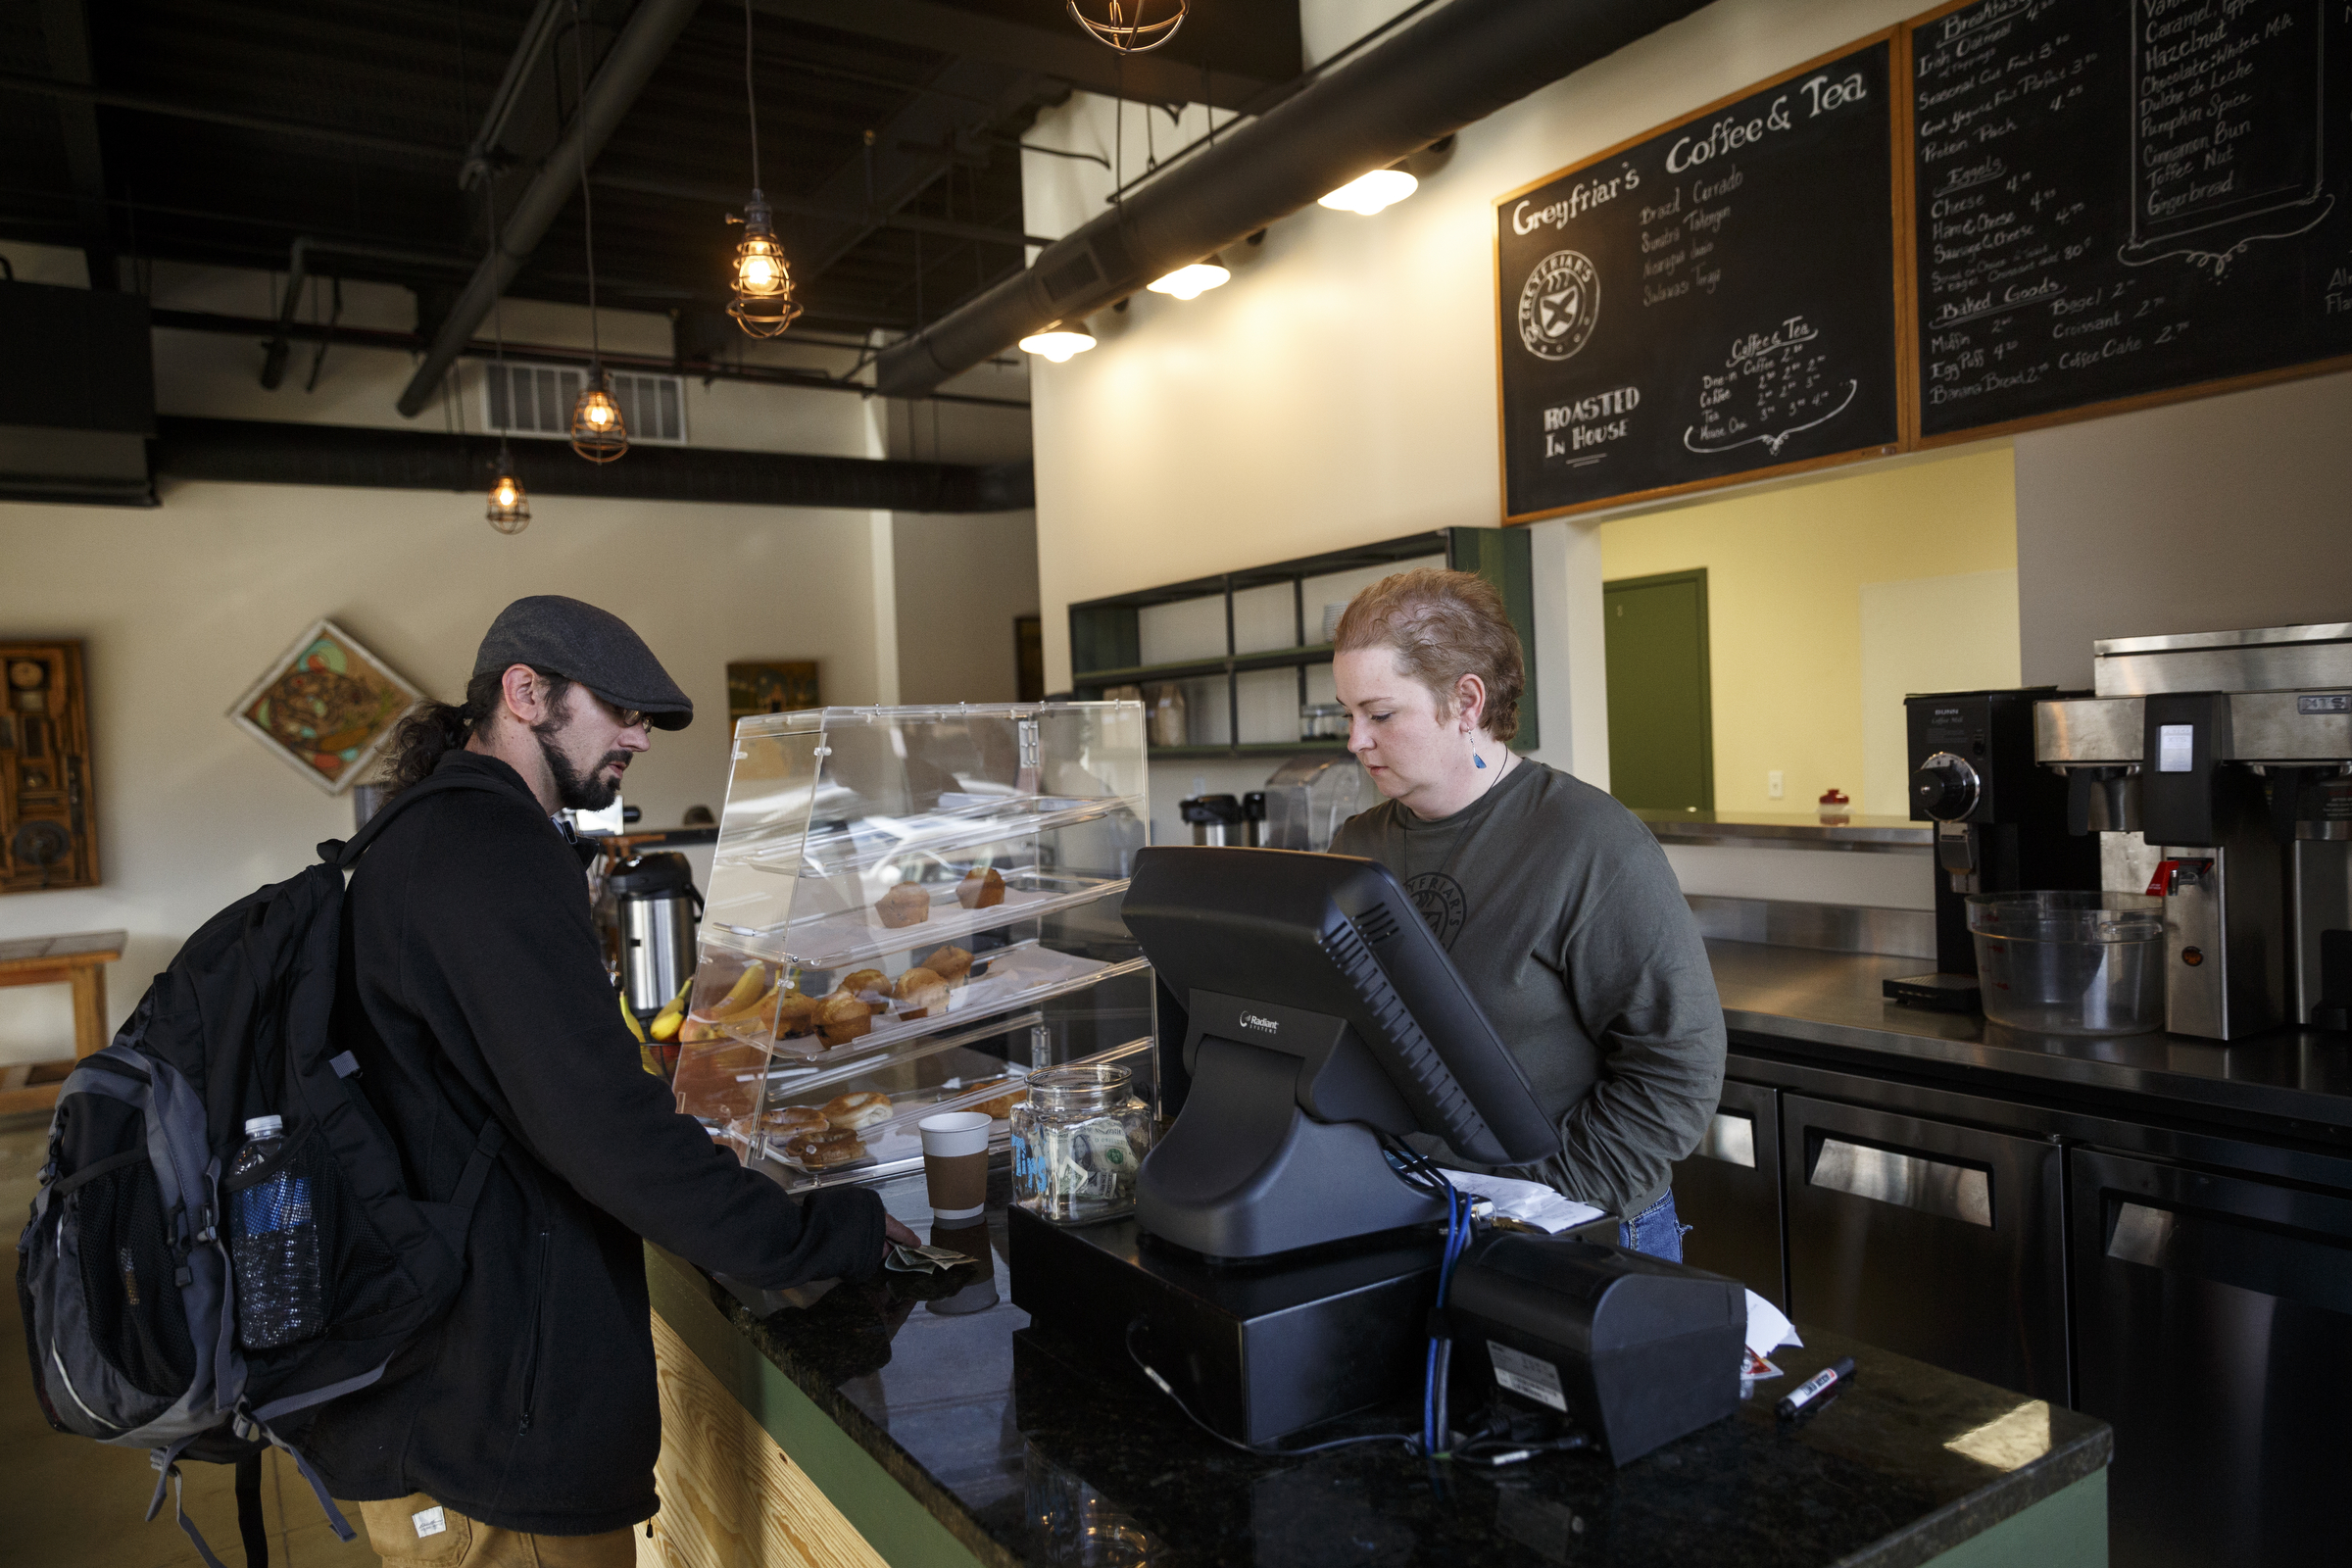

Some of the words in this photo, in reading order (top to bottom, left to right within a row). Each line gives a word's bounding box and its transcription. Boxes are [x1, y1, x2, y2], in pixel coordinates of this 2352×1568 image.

[1956, 22, 2012, 58] Oatmeal
[2265, 13, 2294, 38] Milk
[2144, 19, 2228, 72] Hazelnut
[2210, 59, 2254, 90] Leche
[1919, 75, 1975, 111] Seasonal
[2141, 106, 2202, 139] Pumpkin
[2206, 90, 2252, 120] Spice
[1512, 162, 1641, 236] Greyfriar's
[1666, 117, 1763, 173] Coffee
[1767, 95, 1791, 131] &
[1800, 73, 1866, 118] Tea
[1921, 139, 1968, 163] Protein
[1972, 117, 2018, 142] Pack
[2143, 135, 2209, 168] Cinnamon
[2214, 120, 2251, 145] Bun
[2146, 160, 2194, 190] Toffee
[2204, 143, 2234, 171] Nut
[1639, 186, 1681, 225] Brazil
[1931, 194, 1985, 220] Cheese
[2147, 170, 2234, 216] Gingerbread
[1936, 291, 1991, 319] Baked
[2004, 276, 2059, 303] Goods
[2049, 287, 2100, 317] Bagel
[1732, 333, 1769, 359] Coffee
[1783, 316, 1810, 339] Tea
[1932, 330, 1971, 354] Muffin
[2053, 311, 2123, 339] Croissant
[1743, 356, 1776, 375] Coffee
[1930, 360, 1960, 381] Egg
[2059, 351, 2100, 370] Coffee
[2101, 335, 2142, 359] Cake
[1544, 386, 1641, 432] ROASTED
[1700, 388, 1732, 408] Coffee
[1930, 382, 1982, 405] Banana
[1701, 410, 1720, 423] Tea
[1405, 877, 1461, 926] YFRIAR'S
[1250, 1015, 1279, 1030] Radiant
